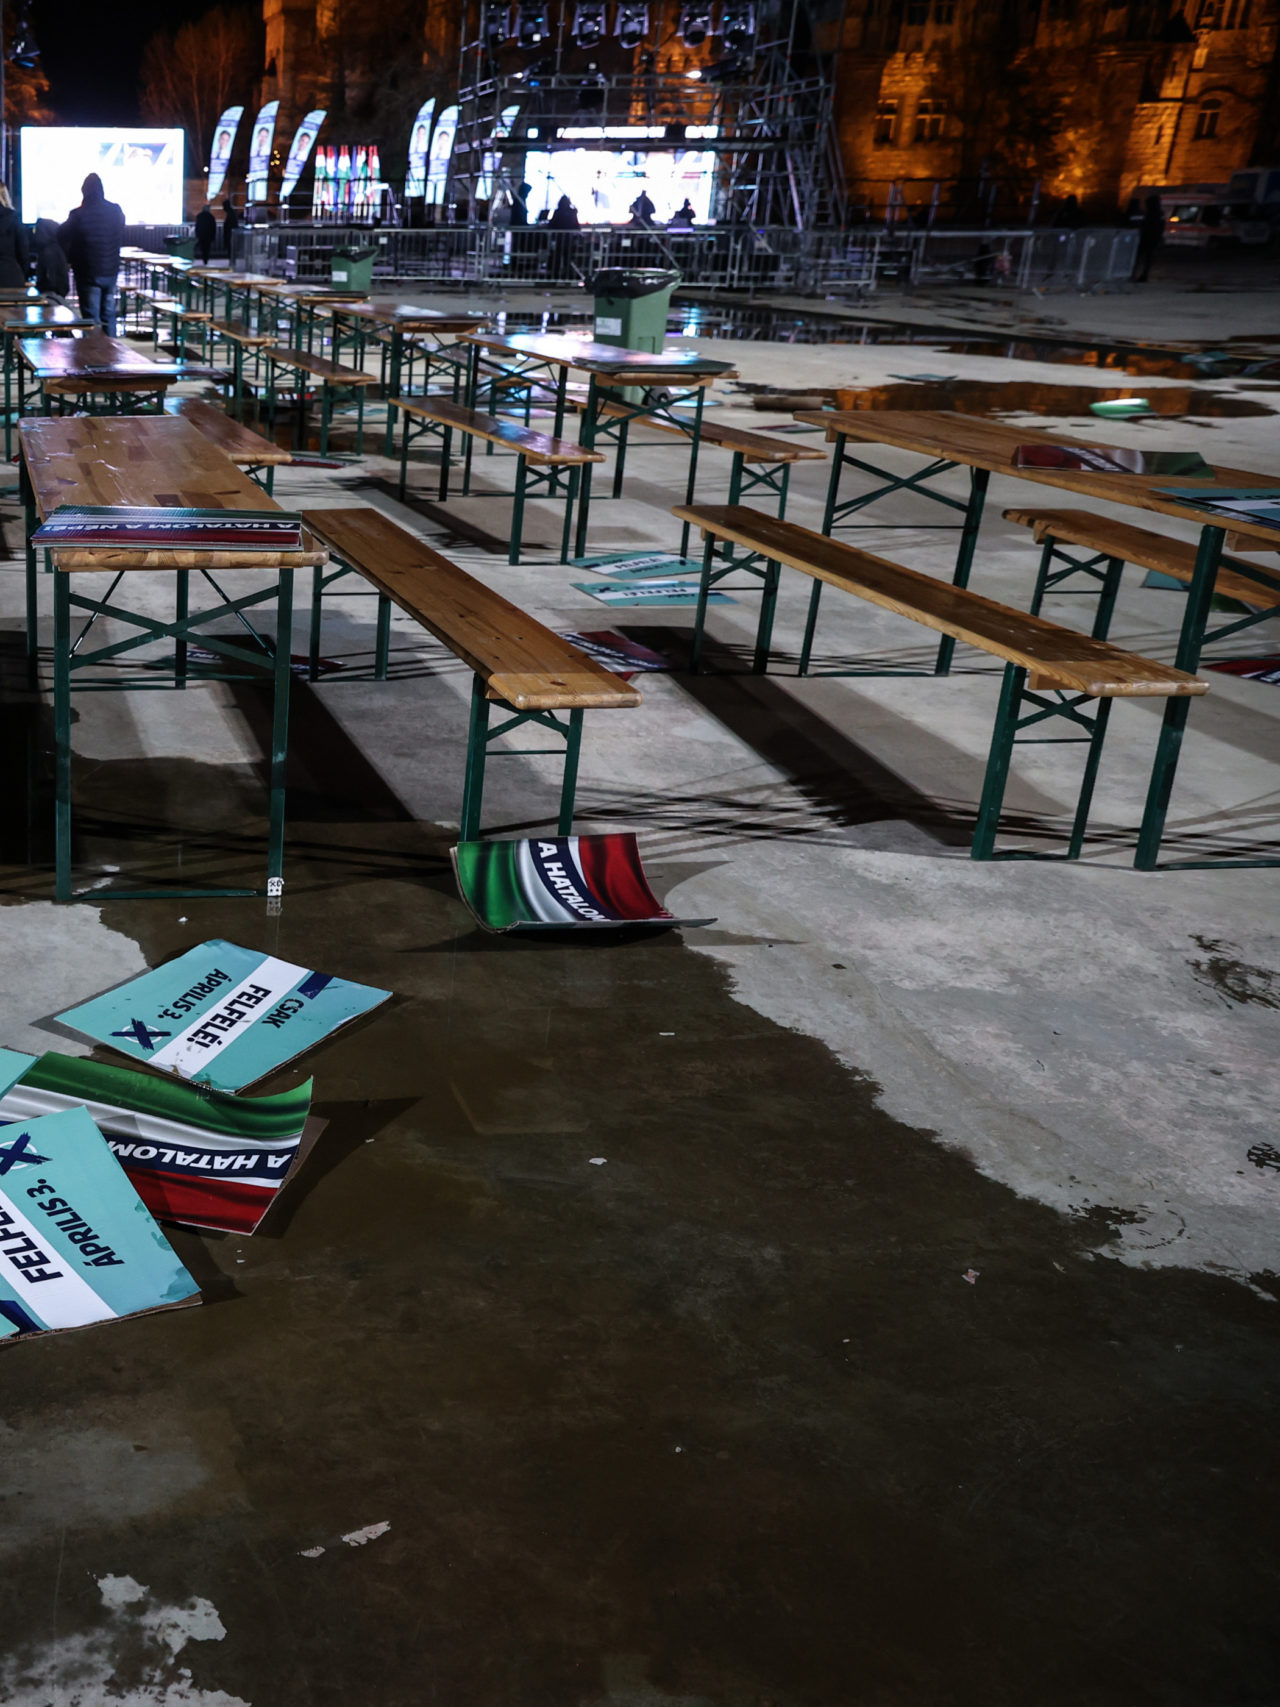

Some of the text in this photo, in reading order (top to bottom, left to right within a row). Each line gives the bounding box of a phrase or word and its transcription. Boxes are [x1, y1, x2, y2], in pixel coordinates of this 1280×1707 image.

[148, 521, 270, 530] HATALOM
[537, 841, 558, 859] A
[157, 968, 232, 1020] ÁPRILIS 3.
[187, 984, 272, 1048] FELFELÉ!
[261, 998, 304, 1028] CSAK
[106, 1141, 292, 1170] A HATALOM
[26, 1178, 125, 1267] ÁPRILIS 3.
